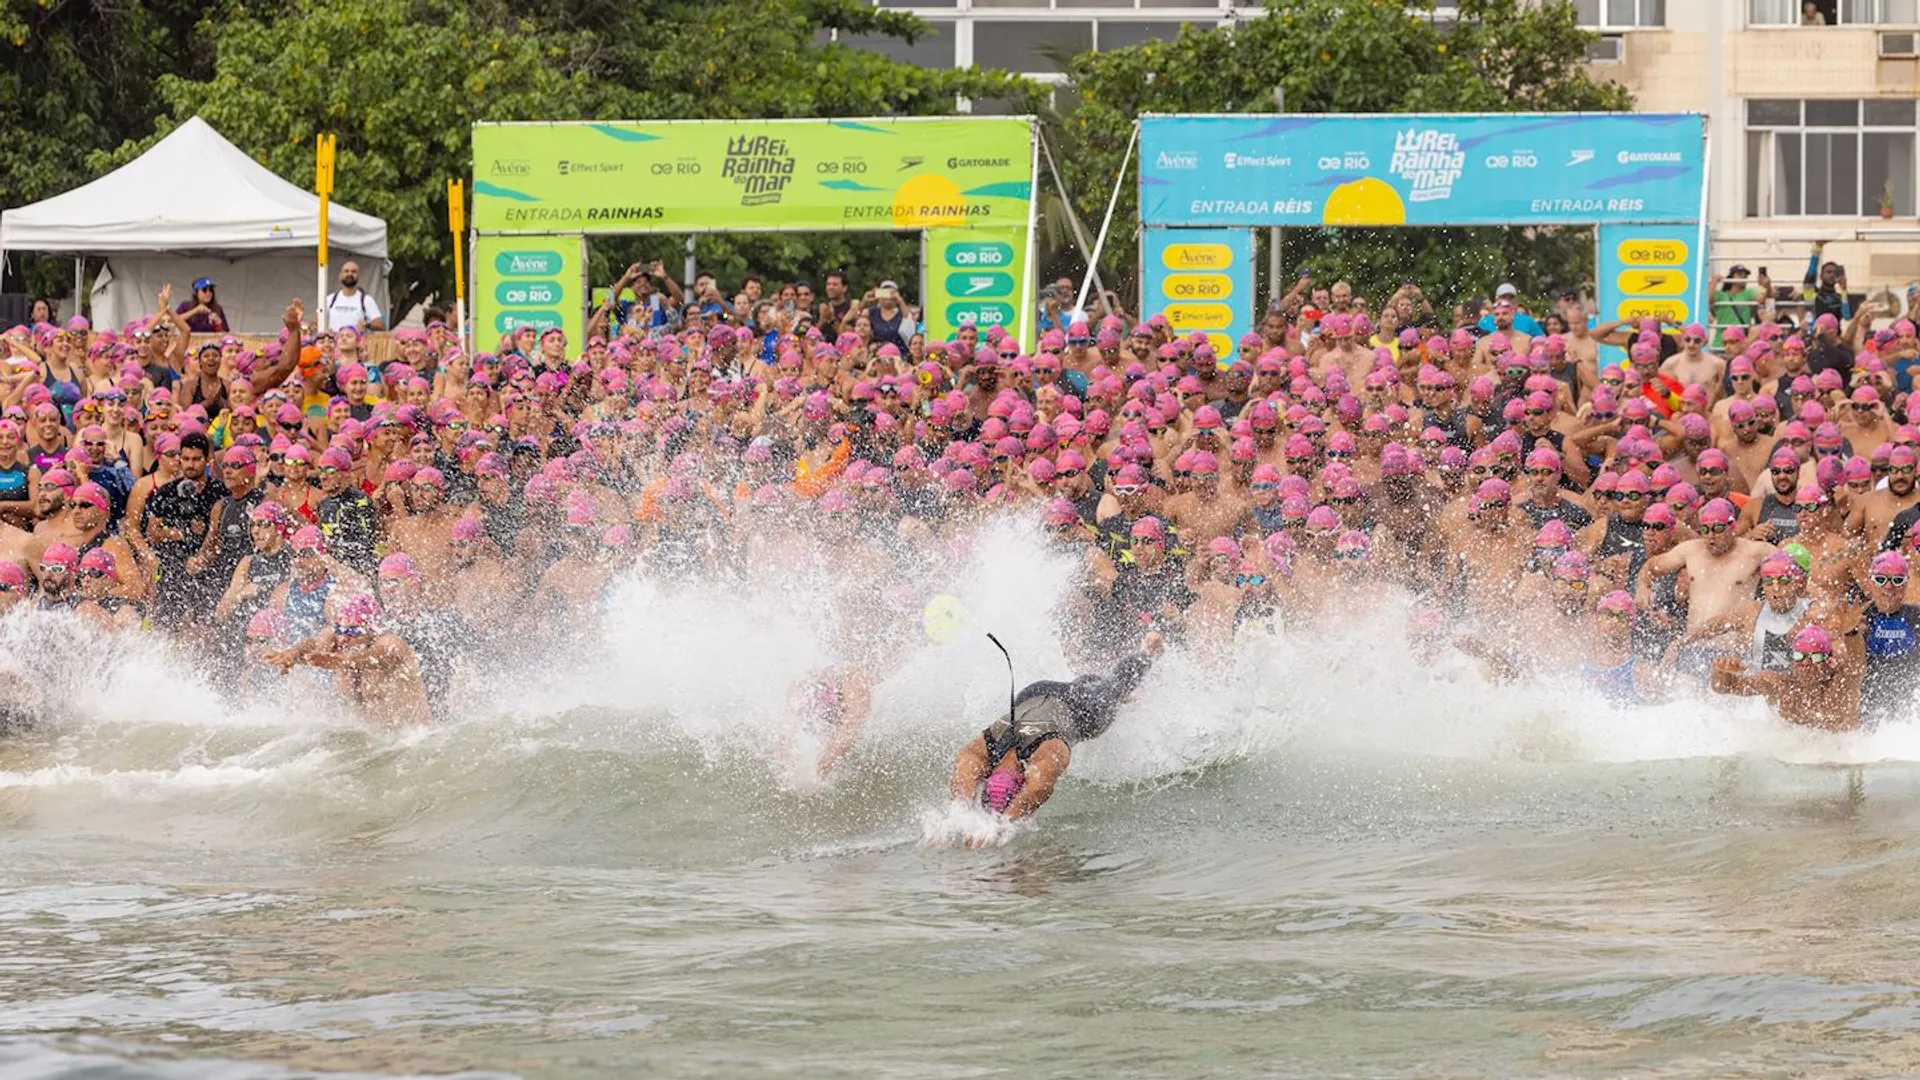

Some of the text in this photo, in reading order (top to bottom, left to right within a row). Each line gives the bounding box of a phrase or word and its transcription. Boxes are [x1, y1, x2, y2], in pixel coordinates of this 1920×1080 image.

[600, 162, 624, 173] Sport
[721, 157, 795, 178] Rainha
[843, 162, 867, 174] RIO
[1345, 156, 1370, 169] RIO
[1512, 155, 1538, 168] RIO
[677, 162, 701, 175] RIO
[843, 204, 991, 219] ENTRADA RAINHAS
[1190, 200, 1268, 215] ENTRADA
[1531, 199, 1644, 213] ENTRADA REIS
[505, 206, 664, 221] ENTRADA RAINHAS
[979, 252, 1002, 264] RIO
[1653, 250, 1676, 261] RIO
[529, 290, 552, 302] RIO
[1198, 284, 1220, 295] RIO
[980, 312, 1003, 324] RIO
